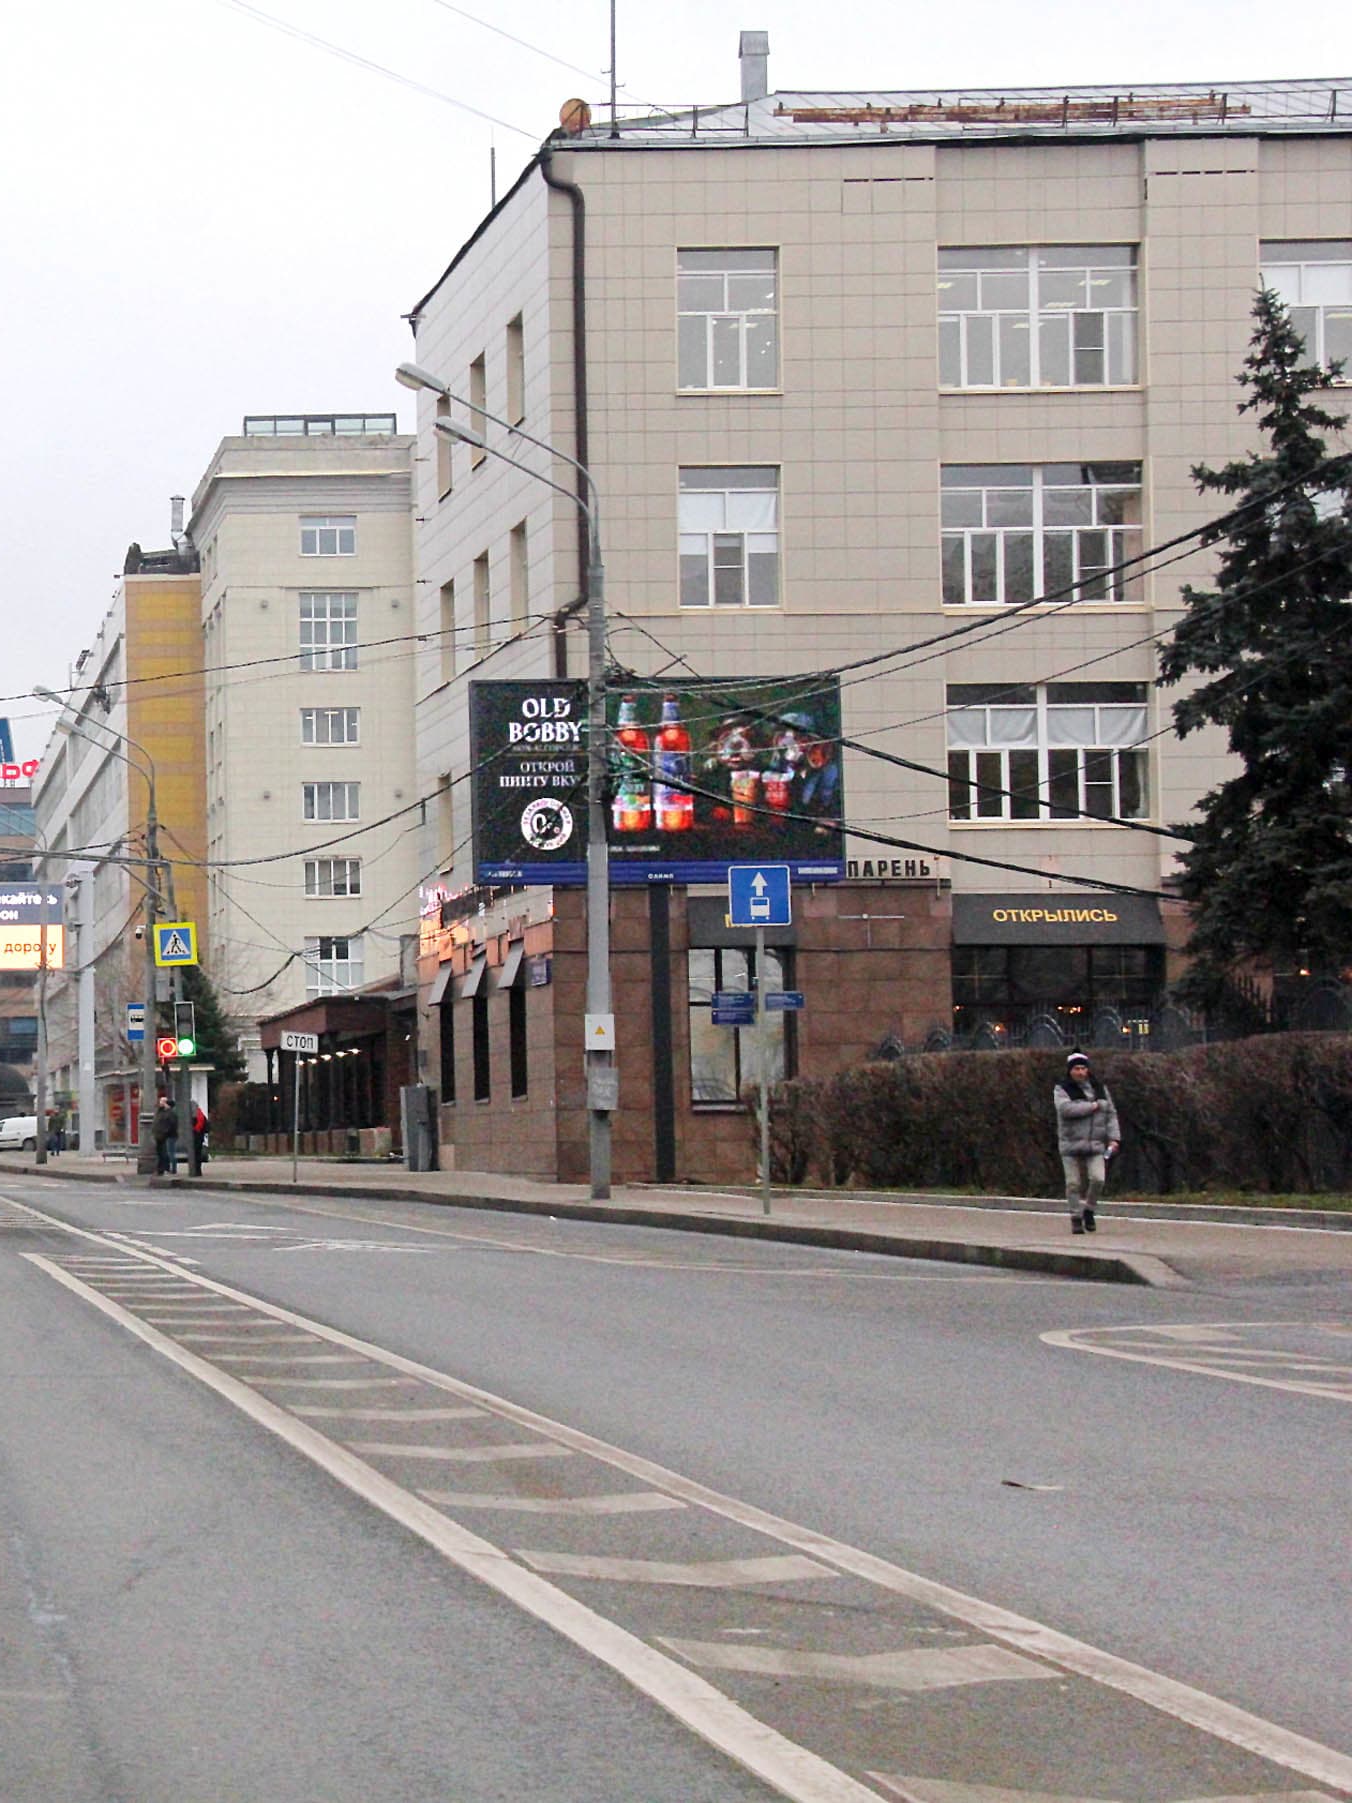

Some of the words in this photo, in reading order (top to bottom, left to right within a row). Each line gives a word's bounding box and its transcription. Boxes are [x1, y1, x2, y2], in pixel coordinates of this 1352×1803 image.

[522, 698, 571, 718] OLD
[509, 722, 583, 742] BOBBY
[520, 760, 575, 773] ОТКРОЙ
[848, 860, 931, 877] ПАРЕНЬ
[992, 908, 1119, 923] ОТКРЫЛИСЬ
[4, 943, 57, 956] дороу
[286, 1034, 314, 1049] СТОП
